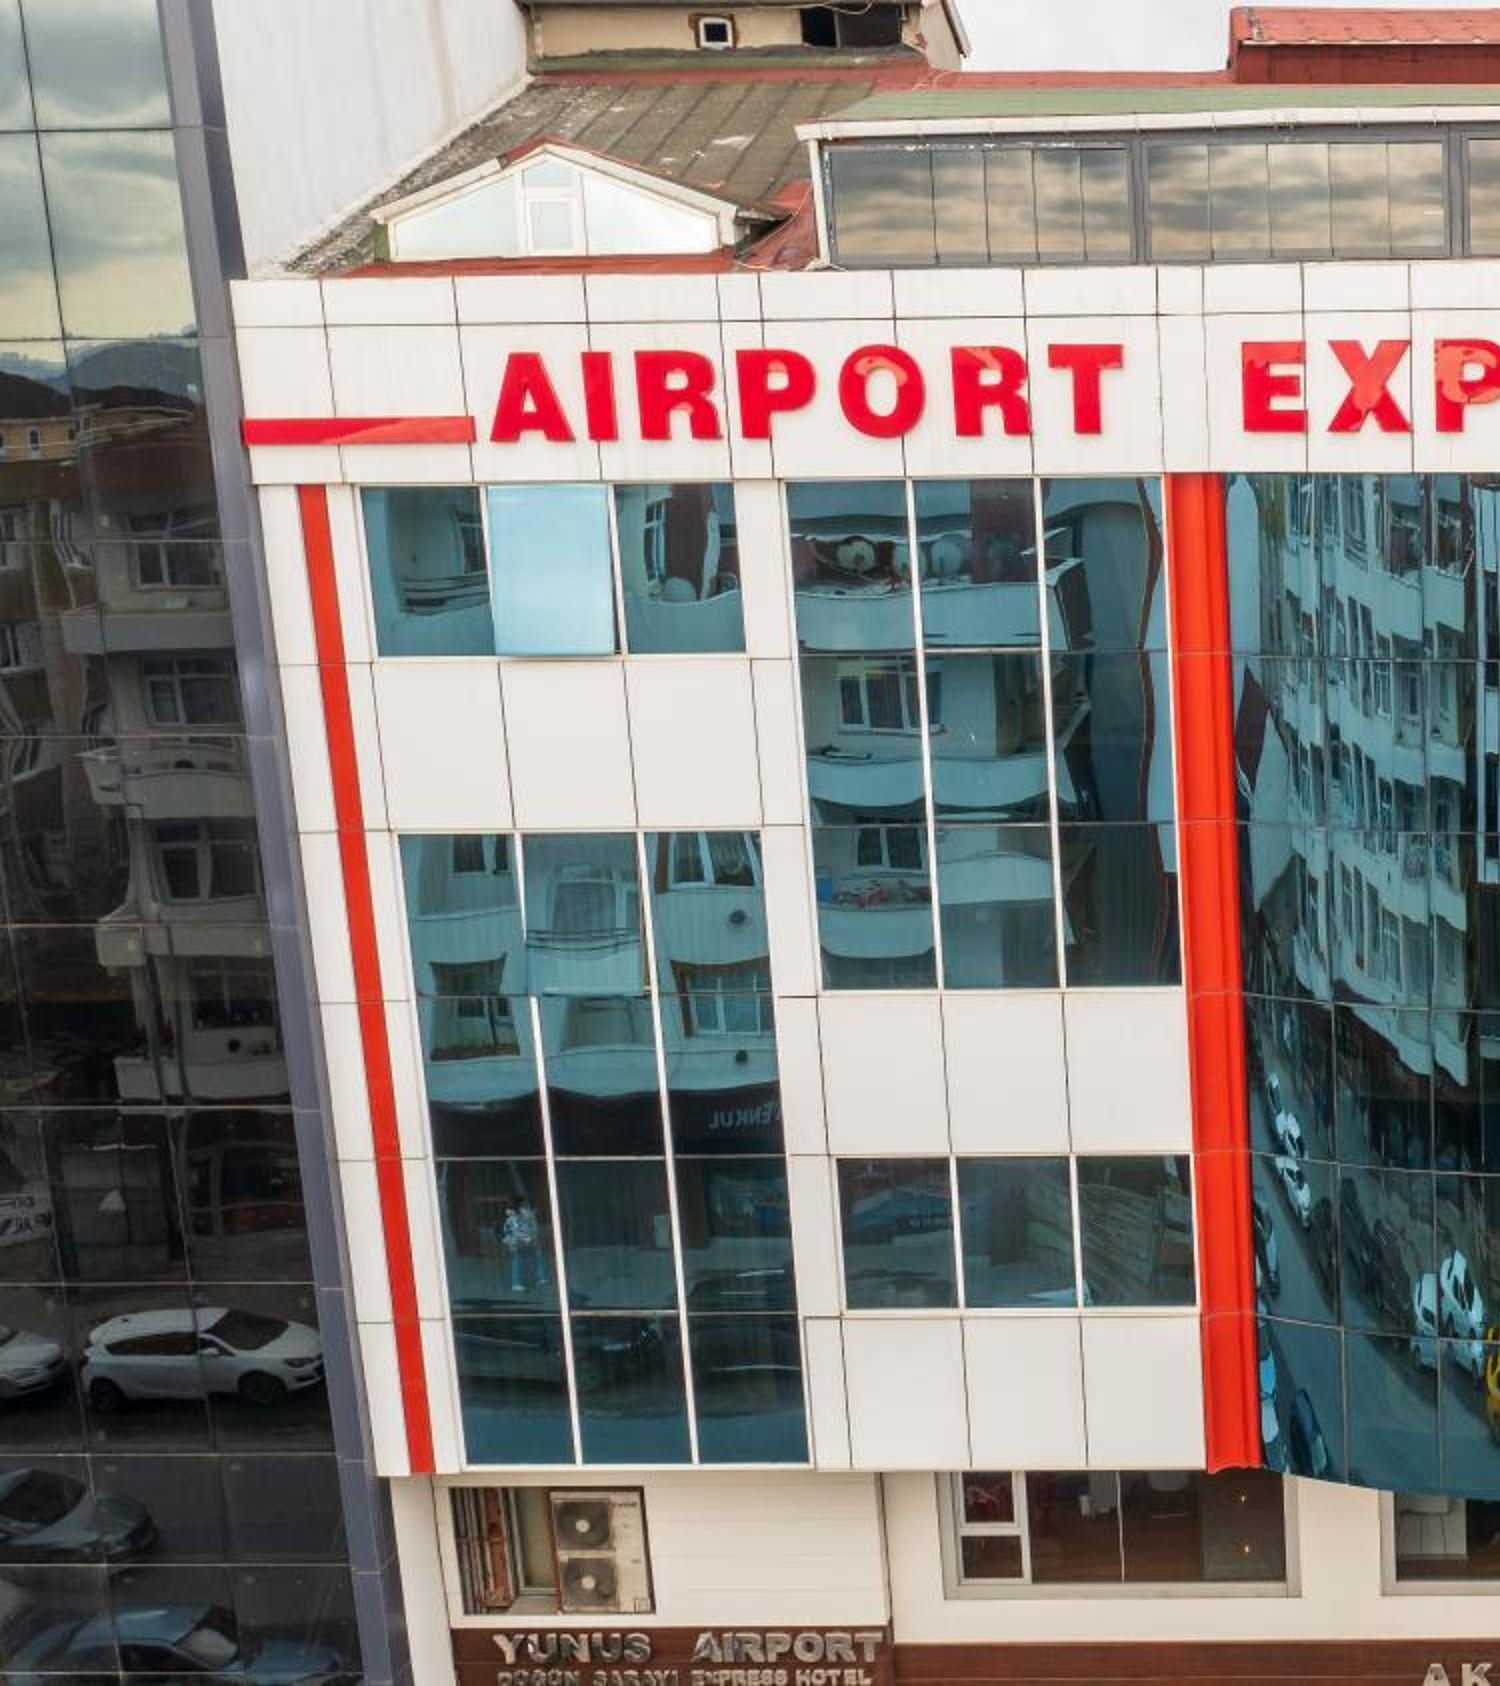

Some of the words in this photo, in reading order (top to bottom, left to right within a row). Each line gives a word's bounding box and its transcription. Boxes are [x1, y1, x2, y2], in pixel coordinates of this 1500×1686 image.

[490, 343, 1124, 443] AIRPORT
[492, 1632, 651, 1665] YUNUS
[691, 1631, 884, 1663] AIRPORT
[795, 1668, 873, 1686] HOTEL
